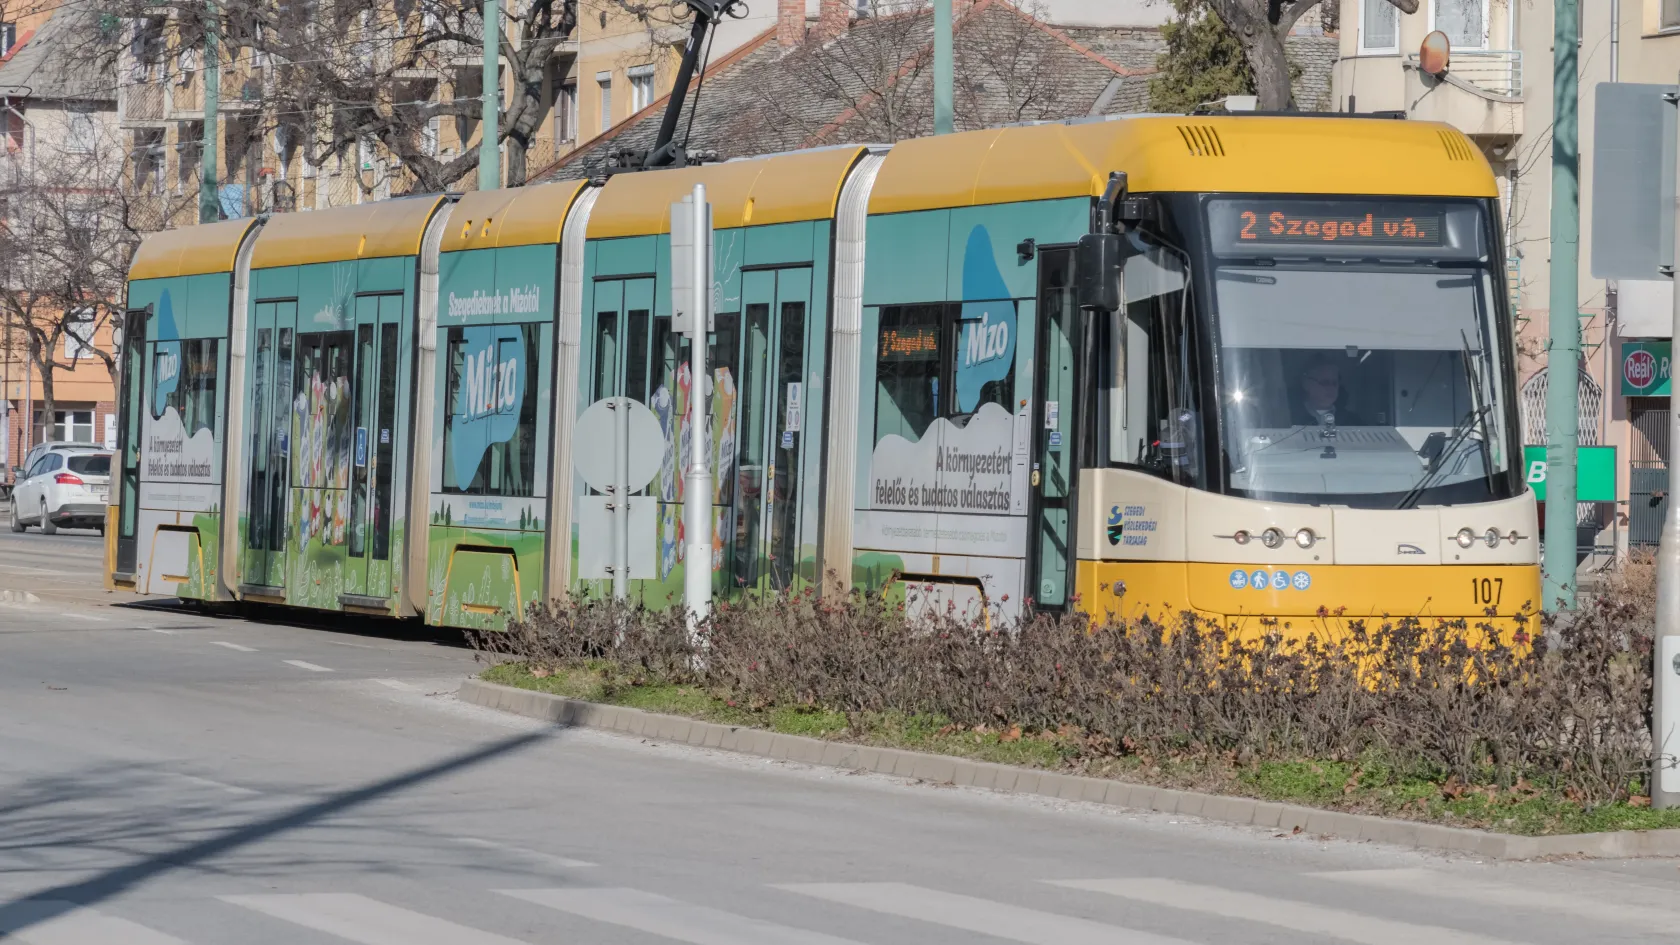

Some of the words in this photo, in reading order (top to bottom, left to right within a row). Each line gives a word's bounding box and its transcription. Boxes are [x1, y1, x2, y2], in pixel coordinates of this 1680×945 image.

[1240, 211, 1257, 239] 2
[1269, 211, 1373, 241] Szeged
[1383, 217, 1425, 238] vá.
[448, 289, 501, 323] Szegedieknek
[503, 295, 508, 313] a
[510, 283, 540, 313] Mizótól
[882, 330, 889, 356] 2
[891, 329, 922, 356] Szeged
[965, 311, 1009, 366] Mizo
[462, 344, 517, 419] Mizo
[1627, 355, 1650, 378] Reál
[936, 445, 944, 471] A
[946, 445, 1012, 480] környezetért
[875, 477, 906, 505] felelős
[908, 478, 919, 505] és
[922, 482, 958, 508] tudatos
[961, 480, 1010, 511] választás
[1472, 577, 1503, 604] 107
